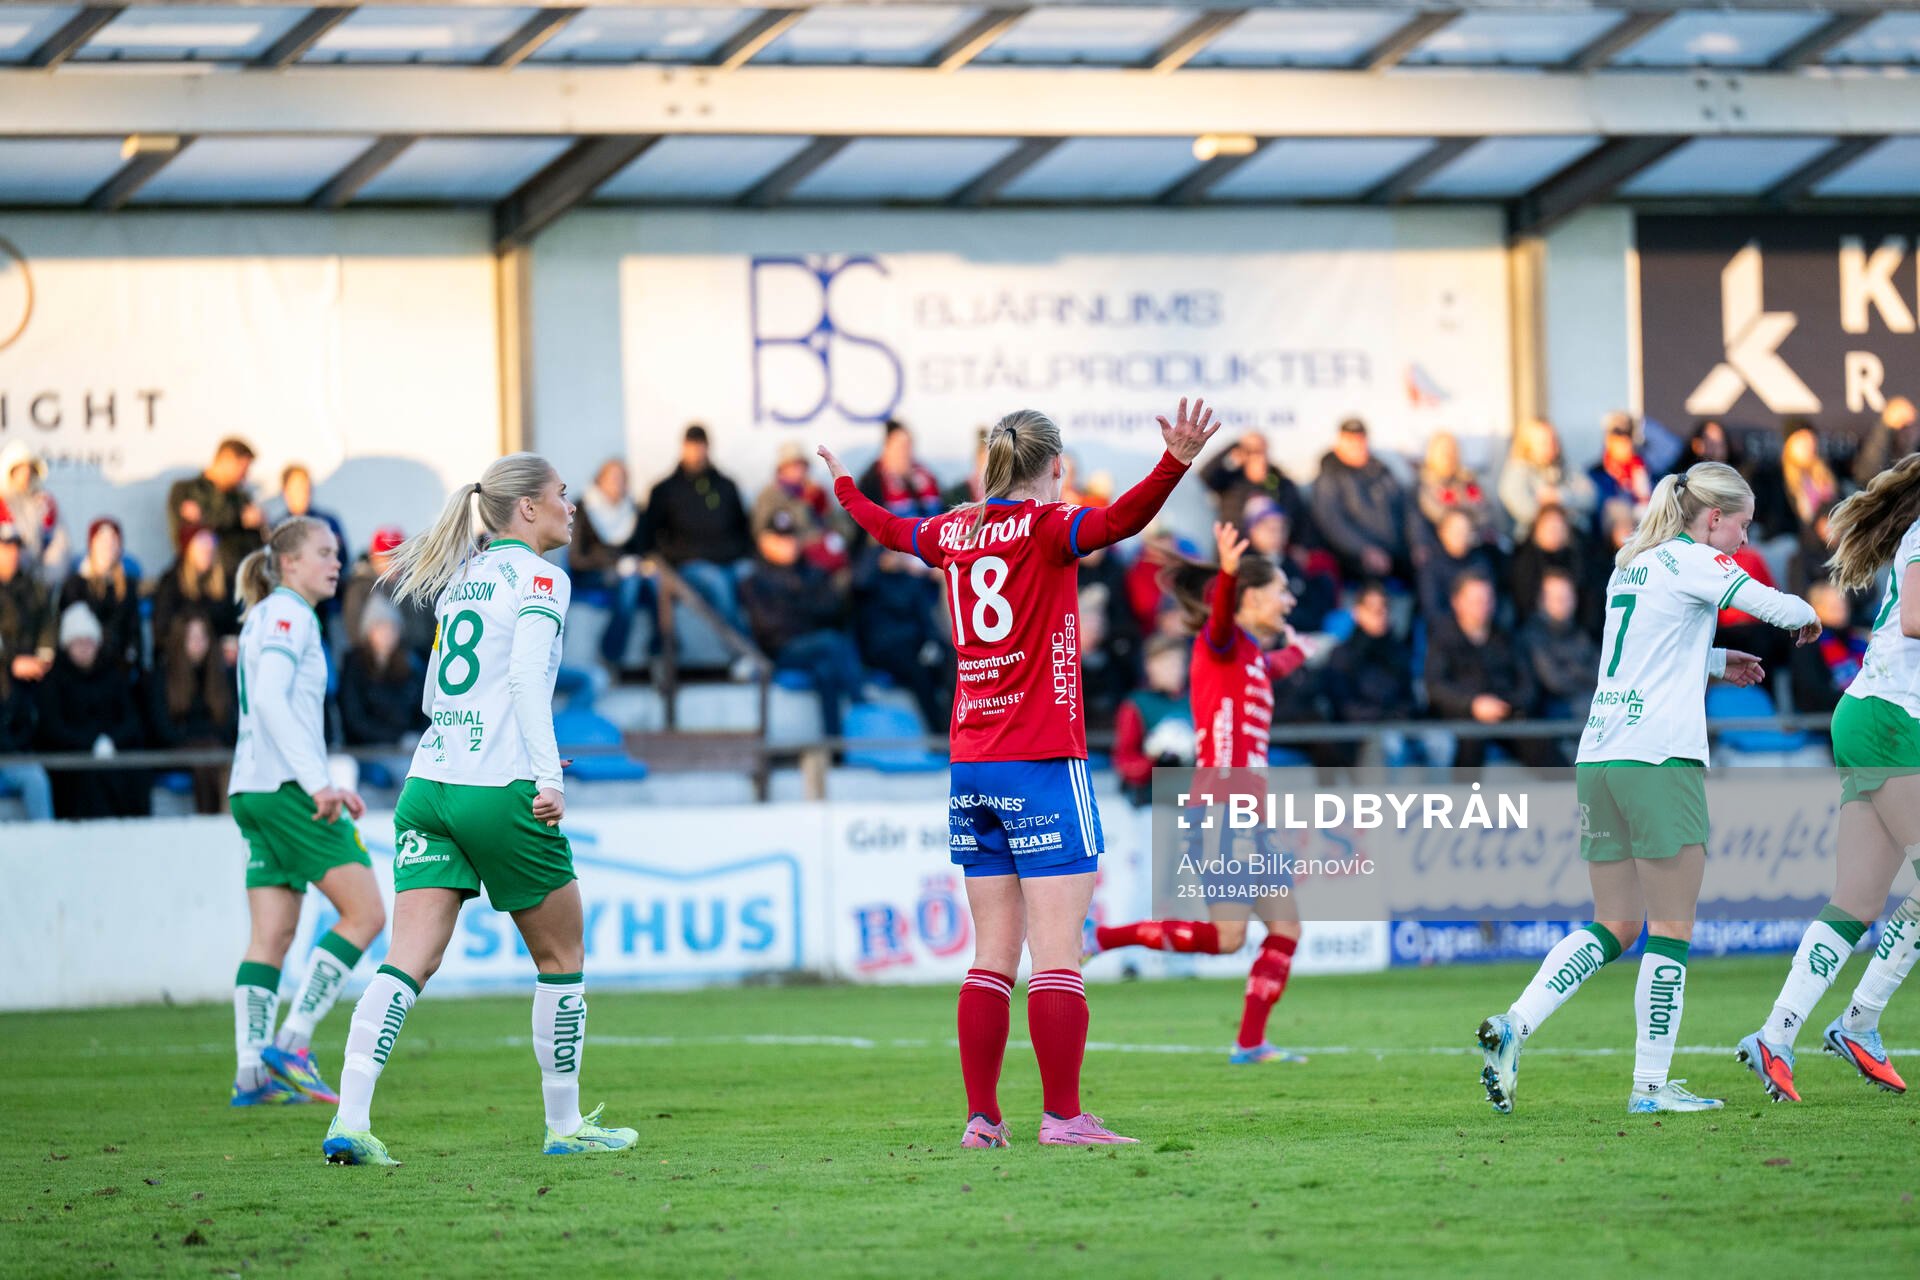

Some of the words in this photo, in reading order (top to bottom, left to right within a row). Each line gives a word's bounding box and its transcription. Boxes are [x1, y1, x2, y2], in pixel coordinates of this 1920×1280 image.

[918, 347, 1371, 393] STÅLPRODUKTER
[948, 556, 1013, 645] 18
[1607, 594, 1637, 677] 7
[1051, 631, 1069, 705] NORDIC
[1064, 613, 1078, 722] WELLNESS
[1549, 941, 1606, 995] Clinton
[1649, 964, 1682, 1037] Clinton
[553, 994, 585, 1073] Clinton
